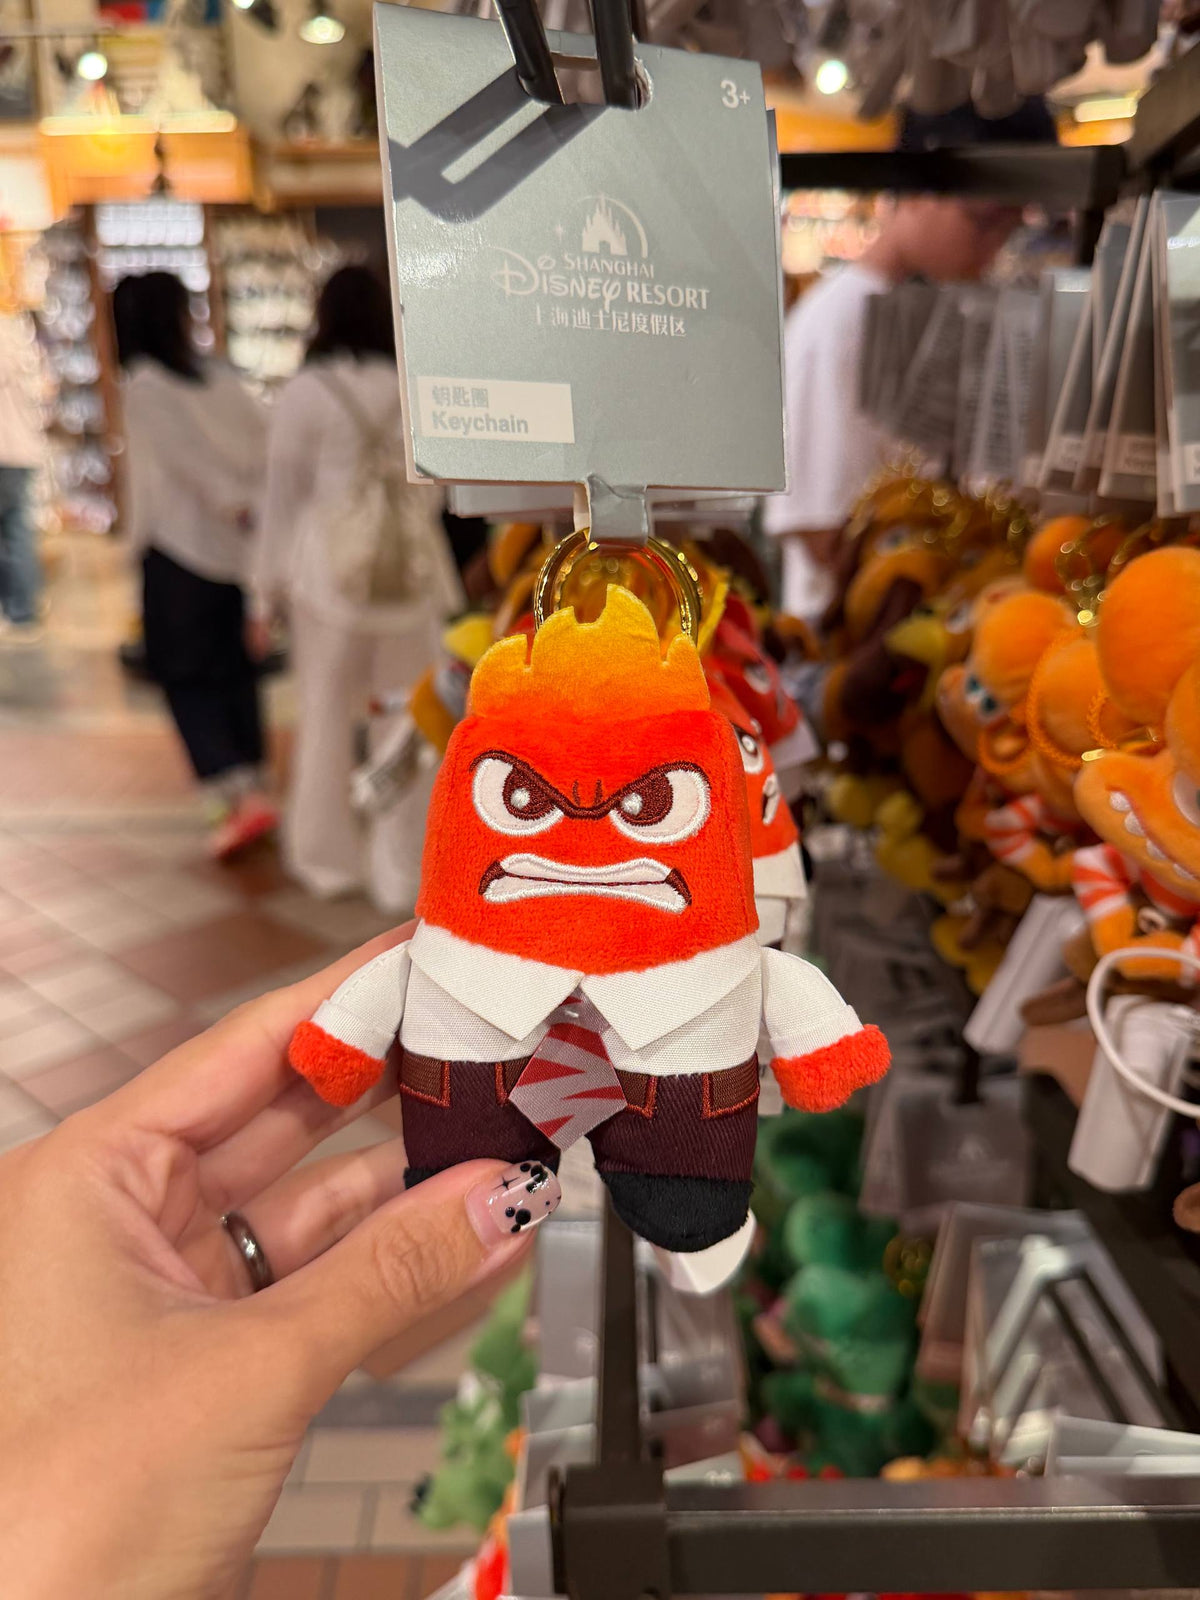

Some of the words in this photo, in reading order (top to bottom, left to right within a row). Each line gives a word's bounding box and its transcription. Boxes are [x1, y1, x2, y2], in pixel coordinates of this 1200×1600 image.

[720, 79, 751, 109] 3+
[562, 253, 655, 279] SHANGHAI
[626, 280, 710, 310] RESORT
[432, 410, 529, 435] Keychain
